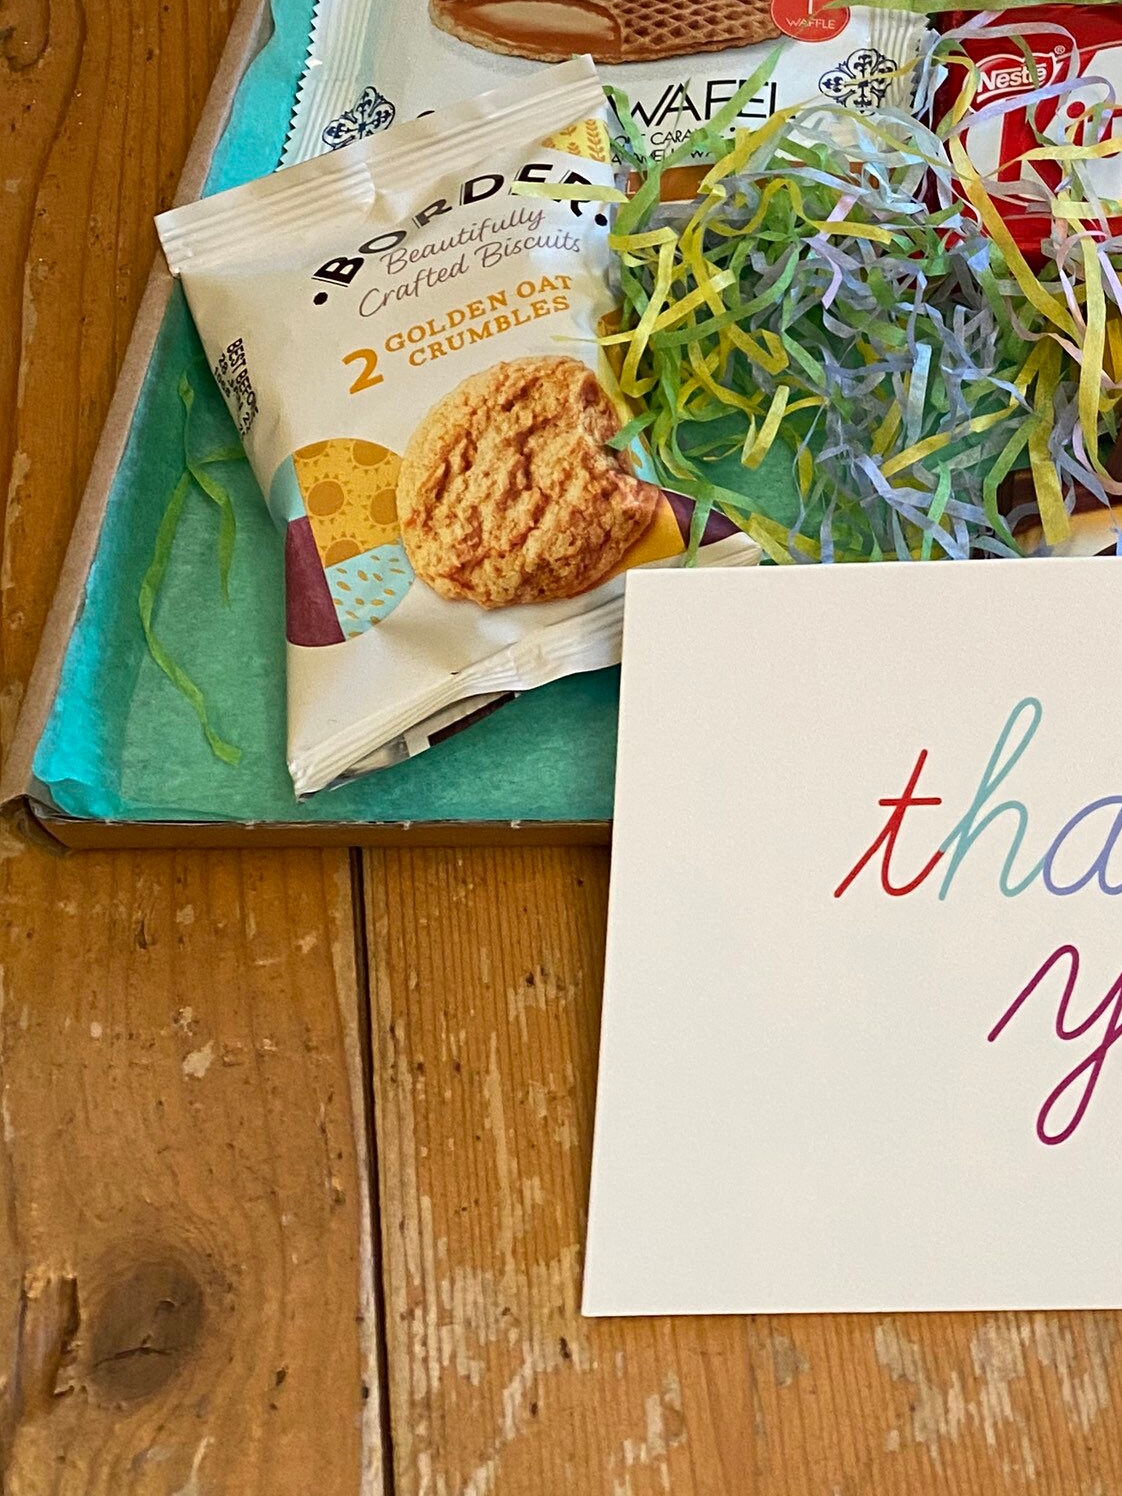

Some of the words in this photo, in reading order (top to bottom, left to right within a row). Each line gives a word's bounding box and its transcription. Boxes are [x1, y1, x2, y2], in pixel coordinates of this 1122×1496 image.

[785, 17, 836, 30] WAFFLE
[358, 254, 469, 318] Crafted
[474, 230, 581, 269] Biscuits
[380, 206, 546, 276] Beautifully
[226, 337, 247, 374] BEST
[341, 347, 385, 395] 2
[384, 290, 508, 353] GOLDEN
[515, 274, 573, 299] OAT
[408, 294, 571, 368] CRUMBLES
